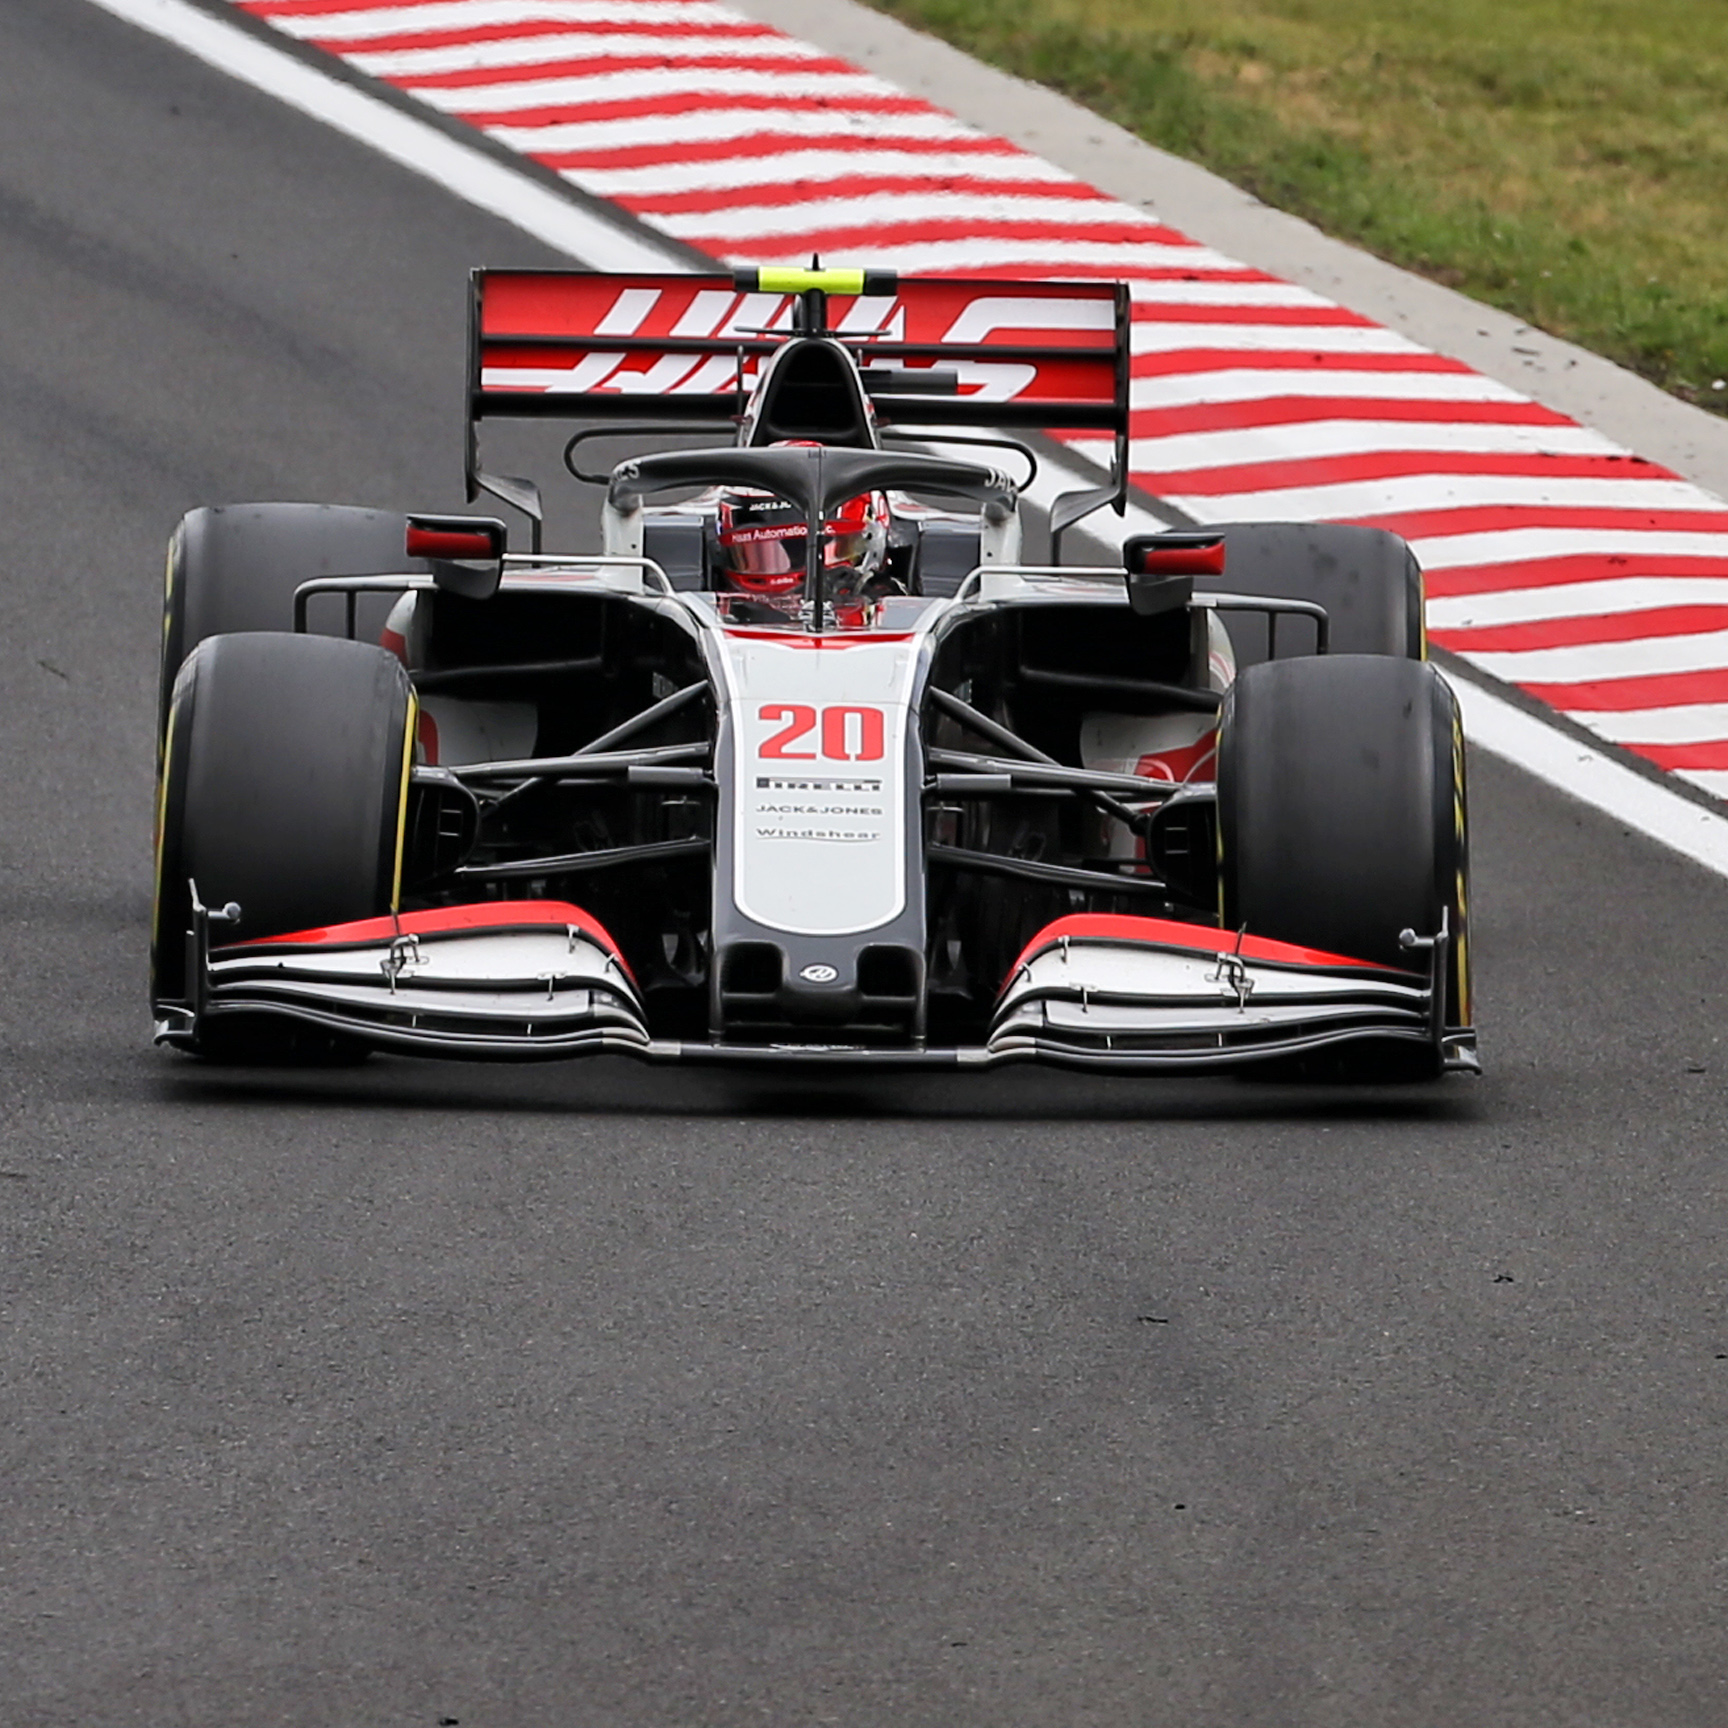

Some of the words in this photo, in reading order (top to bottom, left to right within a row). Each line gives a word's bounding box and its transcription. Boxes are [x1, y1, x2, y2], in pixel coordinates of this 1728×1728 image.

[753, 525, 808, 540] Automatio
[758, 703, 884, 761] 20
[755, 777, 883, 792] PIRELLI
[756, 805, 883, 816] JACK&JONES
[756, 828, 881, 840] Windshear
